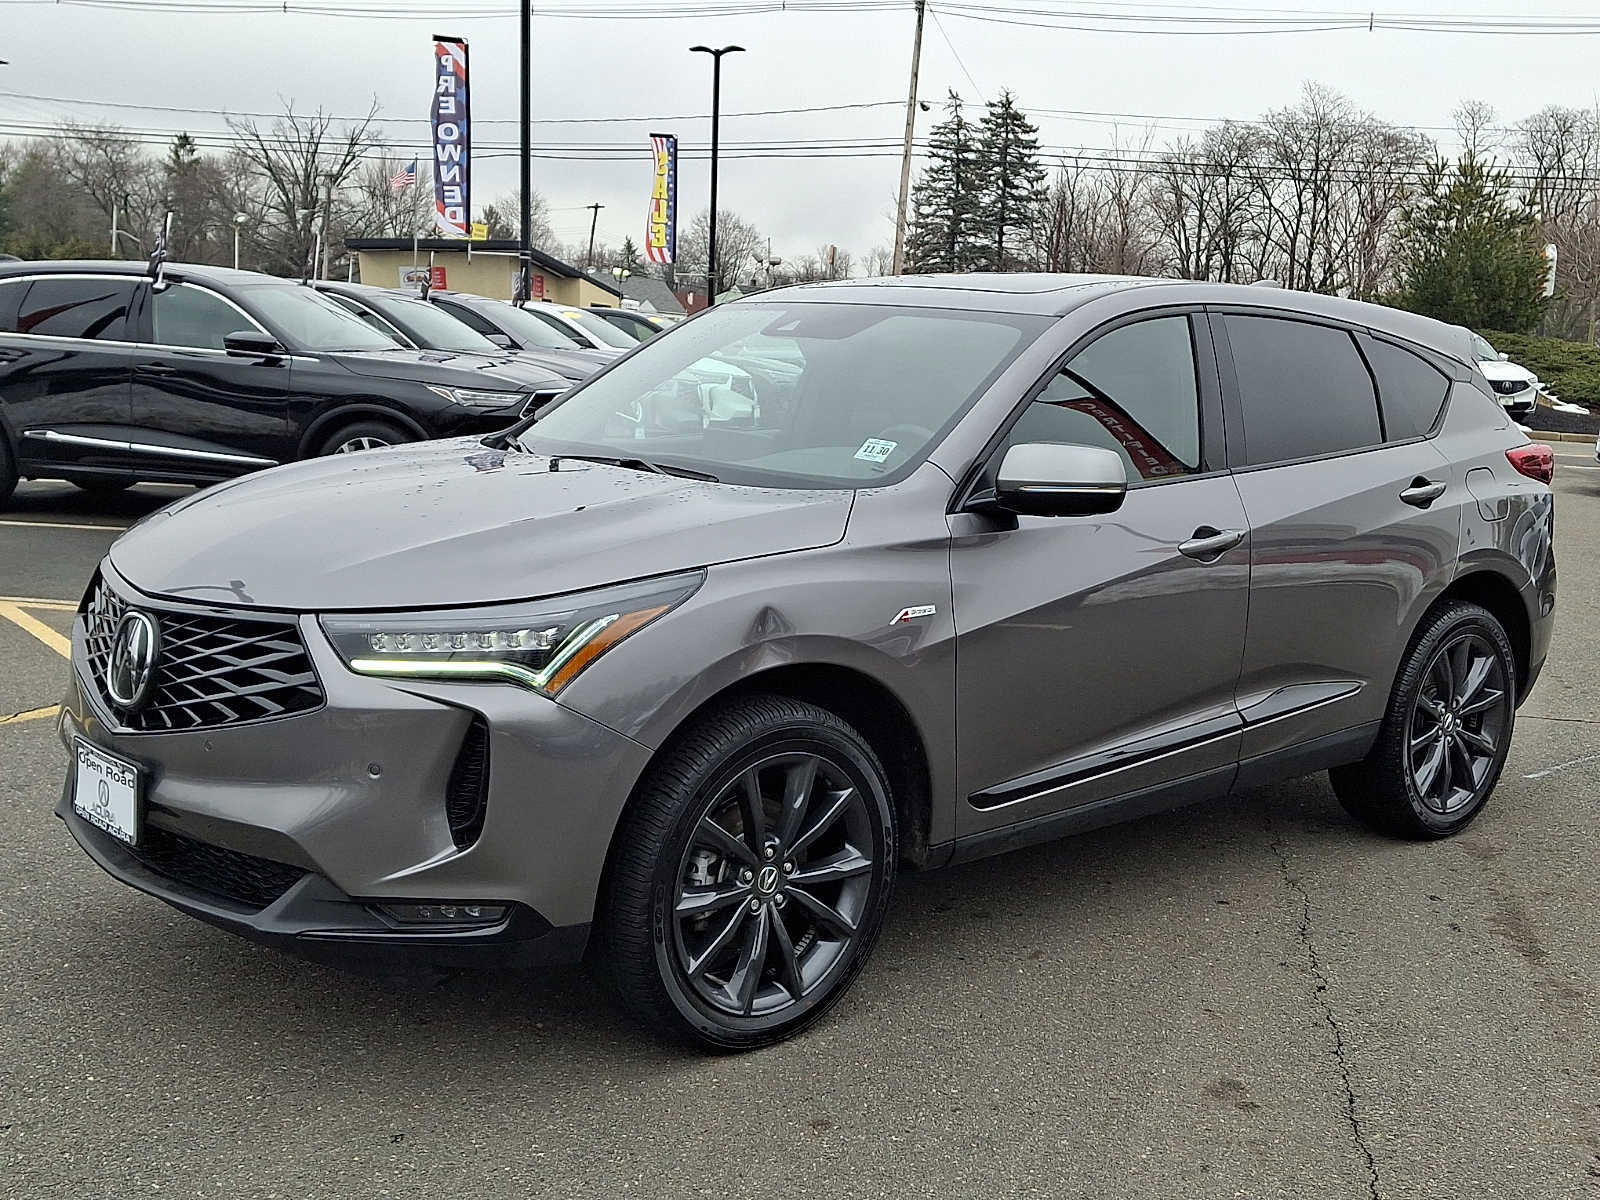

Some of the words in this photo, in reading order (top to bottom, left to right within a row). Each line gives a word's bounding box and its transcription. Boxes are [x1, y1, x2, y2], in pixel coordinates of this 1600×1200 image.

[863, 445, 876, 454] 11
[79, 751, 103, 774] Open
[105, 766, 135, 789] Road
